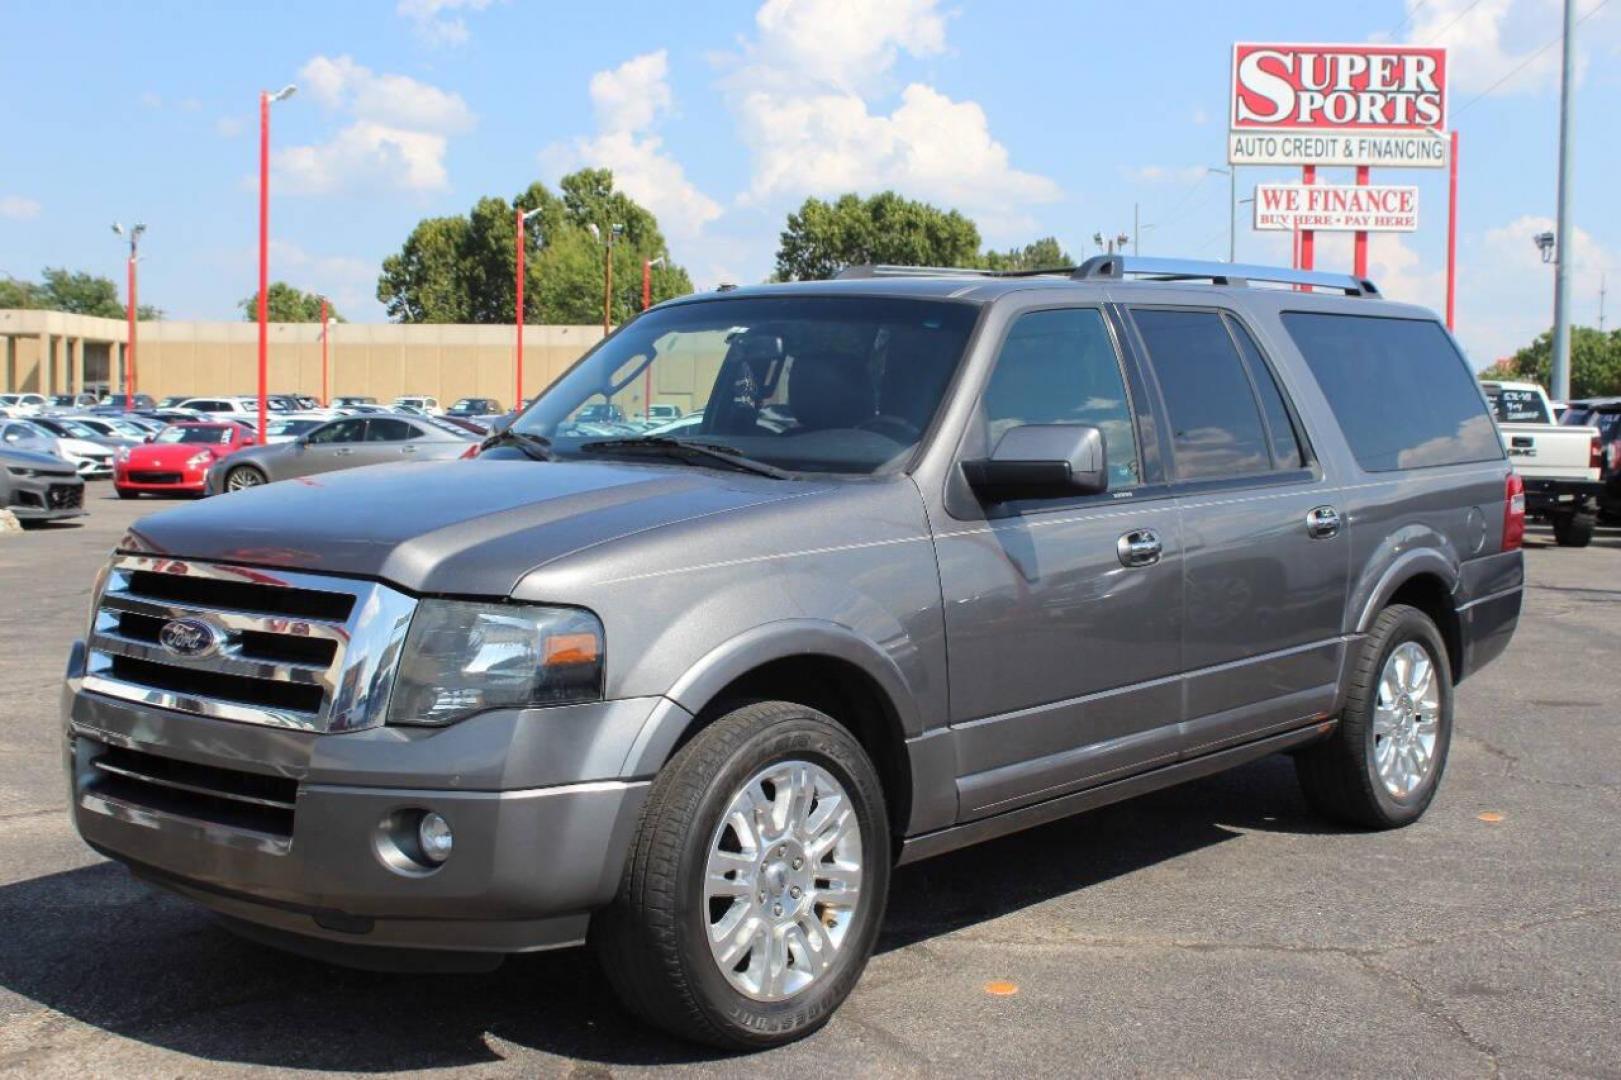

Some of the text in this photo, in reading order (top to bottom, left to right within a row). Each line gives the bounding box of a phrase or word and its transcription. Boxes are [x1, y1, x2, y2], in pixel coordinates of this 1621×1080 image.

[1239, 50, 1439, 123] SUPER
[1234, 137, 1443, 159] AUTO CREDIT & FINANCING
[1262, 189, 1414, 213] WE FINANCE
[1260, 214, 1415, 227] BUY HERE PAY HERE
